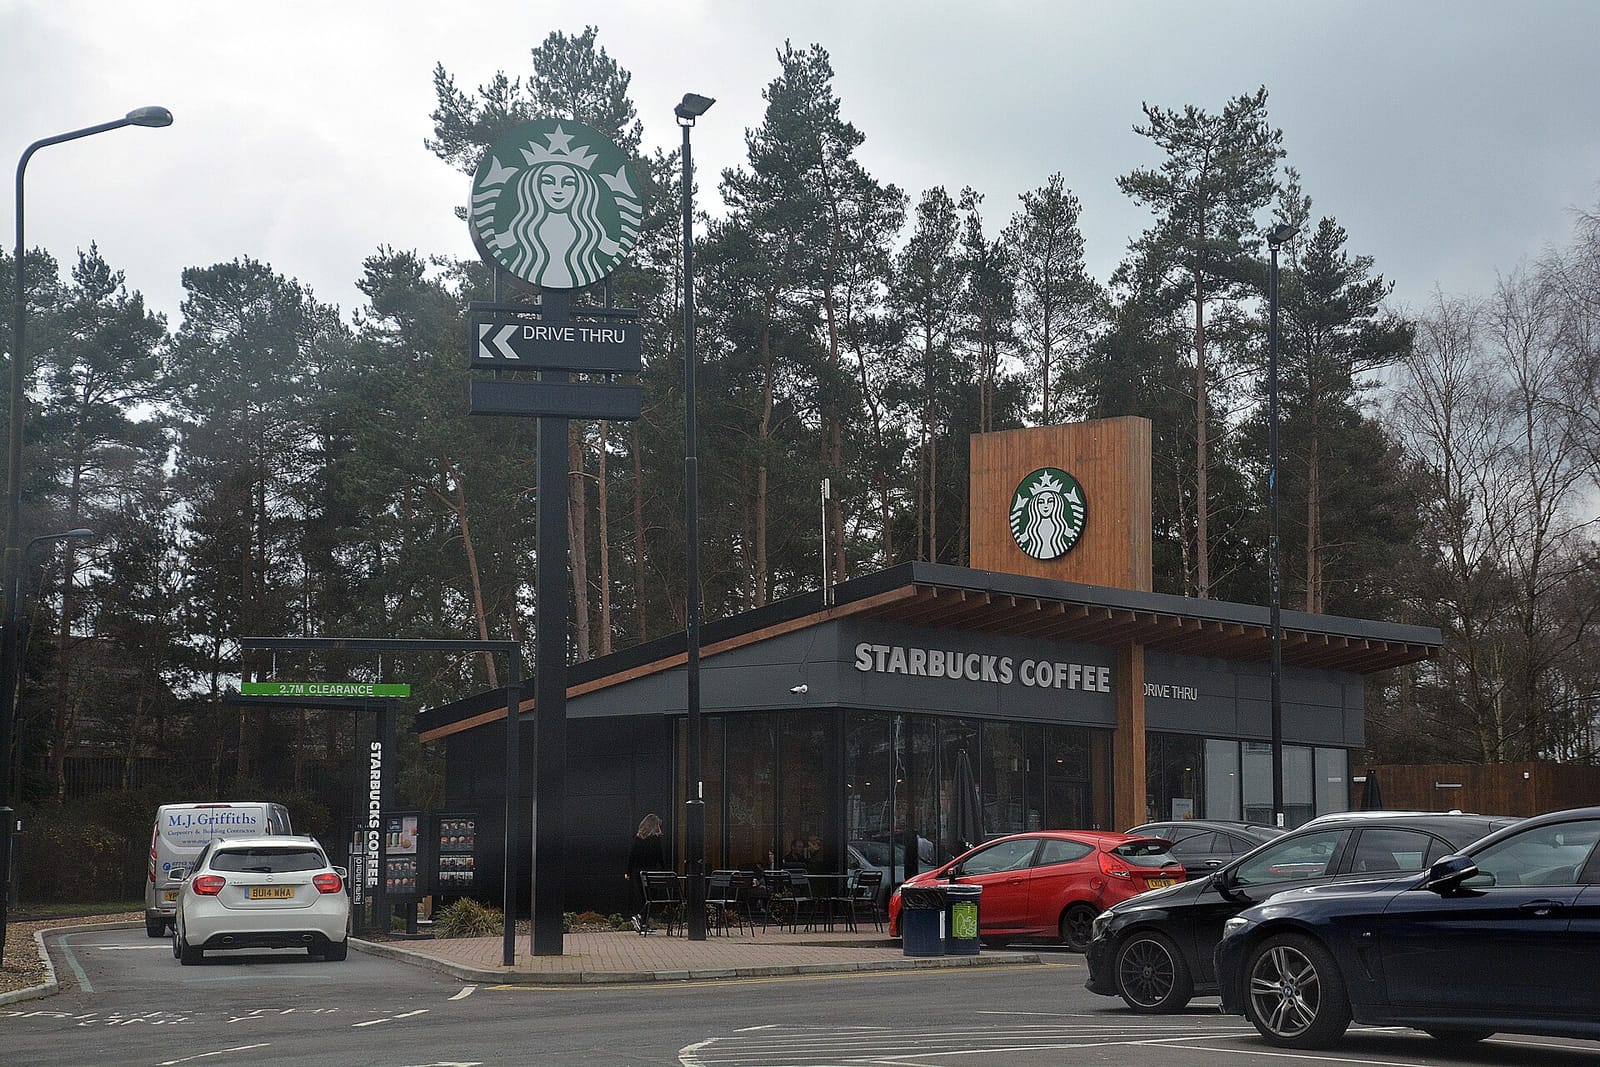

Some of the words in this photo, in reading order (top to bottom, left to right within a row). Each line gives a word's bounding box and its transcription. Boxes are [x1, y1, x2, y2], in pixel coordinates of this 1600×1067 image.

[523, 326, 574, 342] DRIVE
[579, 328, 625, 343] THRU
[854, 642, 1014, 685] STARBUCKS
[1018, 659, 1111, 694] COFFEE
[279, 685, 304, 694] 2.7M
[308, 685, 374, 695] CLEARANCE
[1171, 685, 1198, 701] THRU
[369, 741, 382, 828] STARBUCKS
[367, 830, 380, 886] COFFEE
